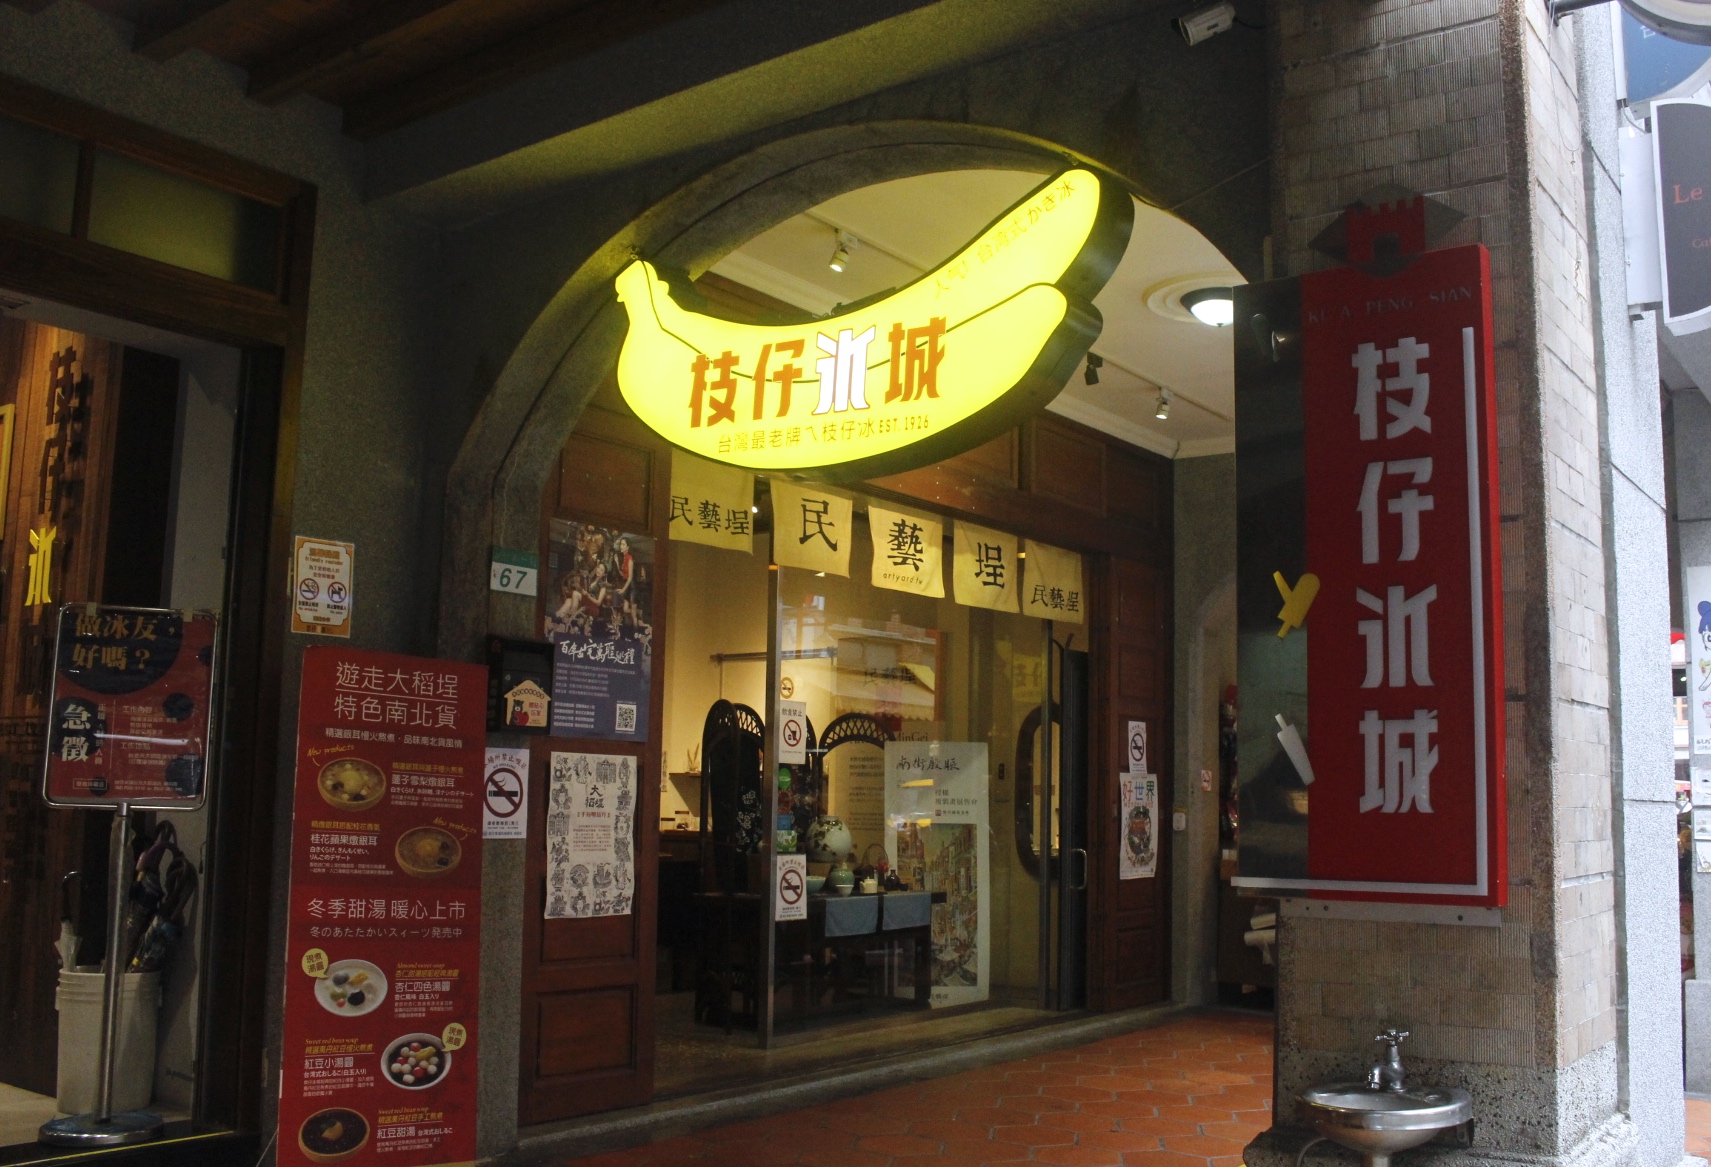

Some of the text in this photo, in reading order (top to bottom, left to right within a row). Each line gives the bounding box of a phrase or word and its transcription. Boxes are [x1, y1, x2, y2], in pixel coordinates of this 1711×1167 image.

[1673, 184, 1703, 204] Le
[1429, 285, 1472, 304] SIAN
[688, 316, 947, 428] 枝仔冰城
[905, 415, 929, 430] 1926
[669, 495, 750, 536] 民藝埕
[798, 498, 1006, 589] 民 藝 埕
[500, 568, 527, 589] 67
[1351, 336, 1439, 813] 枝仔冰城
[1031, 584, 1080, 613] 民藝埕
[335, 661, 458, 698] 遊走大稻埕
[334, 694, 457, 730] 特色南北貨
[62, 704, 91, 762] 急徵
